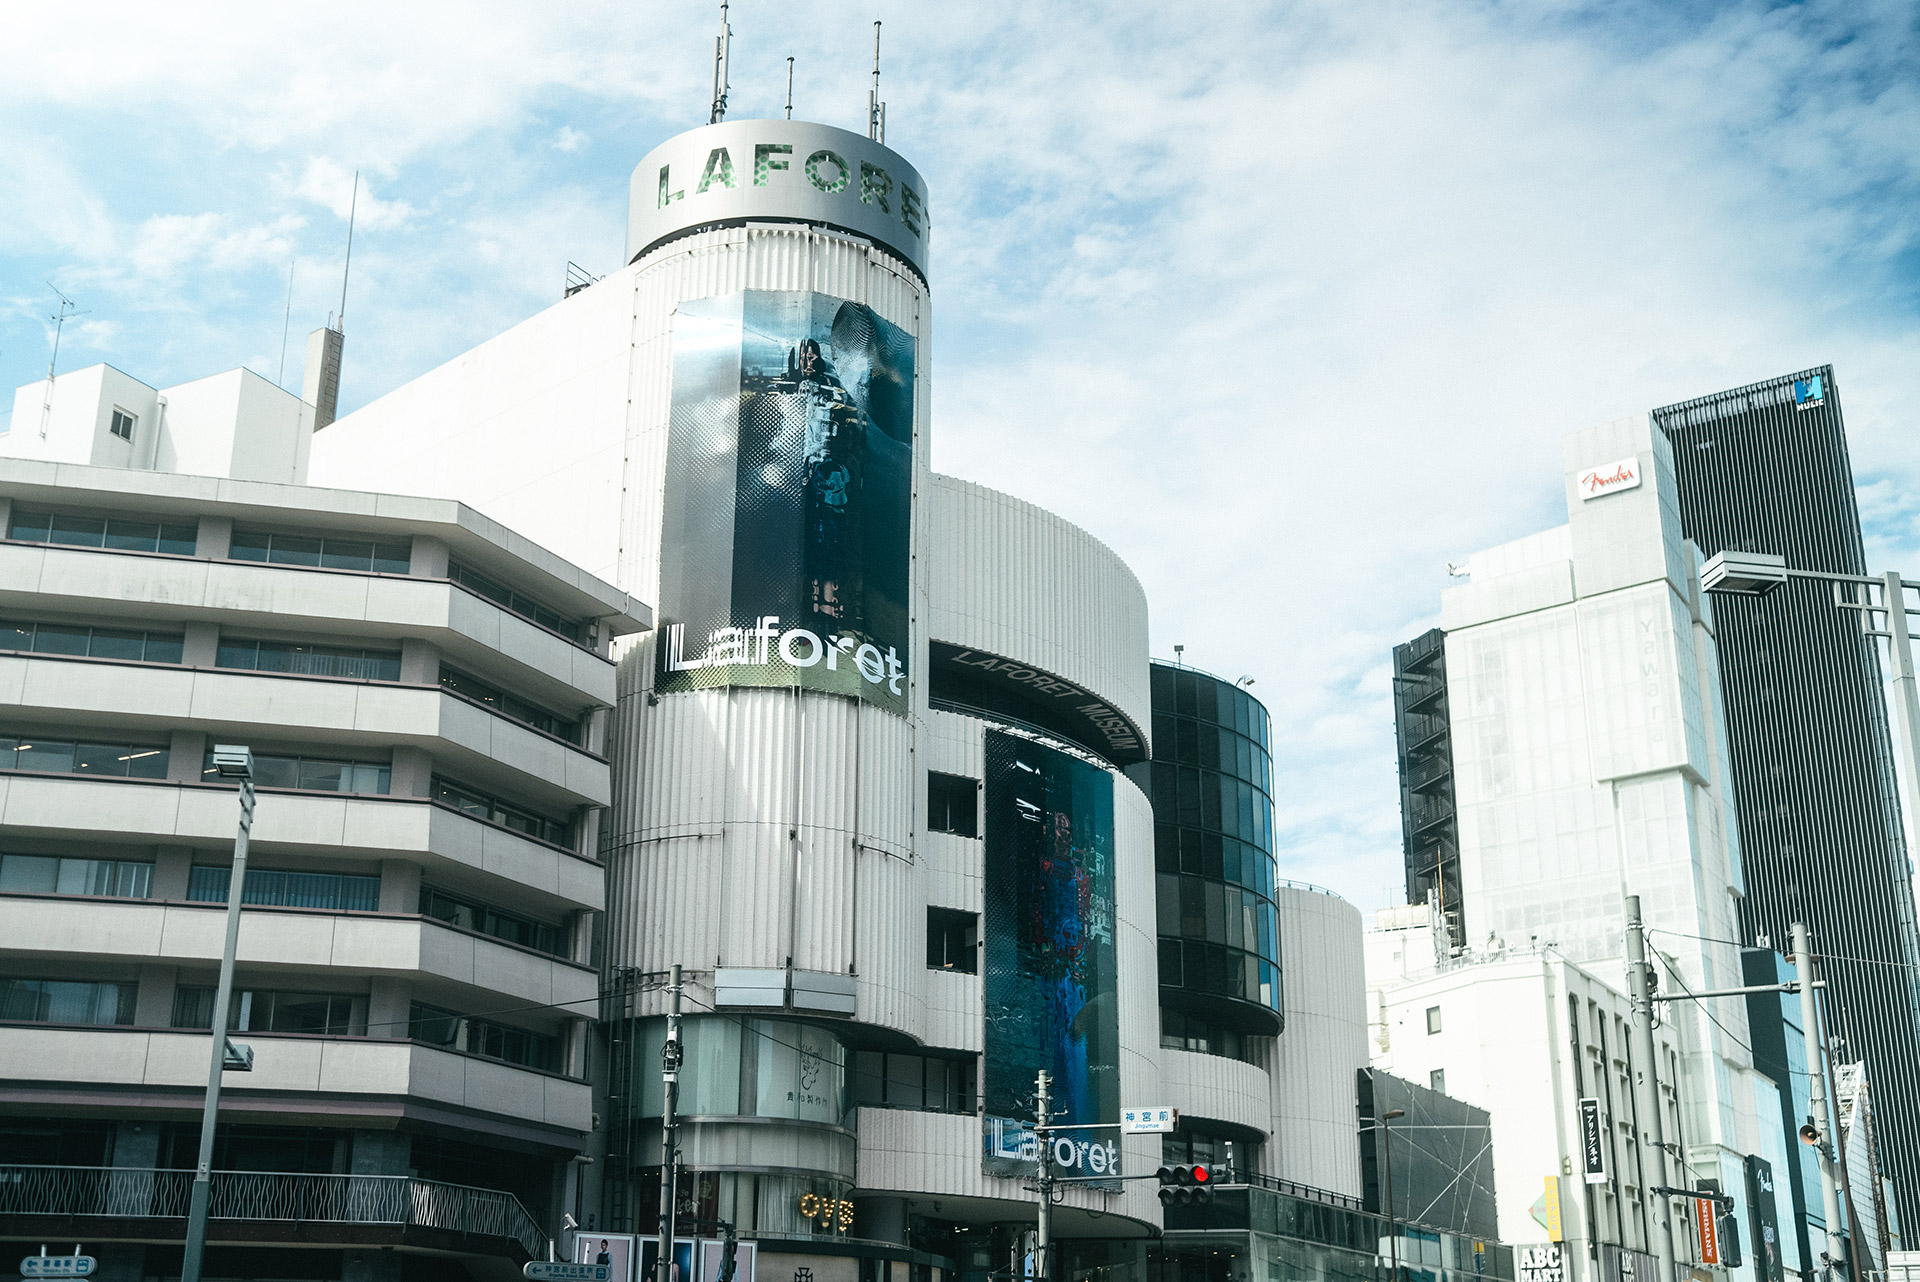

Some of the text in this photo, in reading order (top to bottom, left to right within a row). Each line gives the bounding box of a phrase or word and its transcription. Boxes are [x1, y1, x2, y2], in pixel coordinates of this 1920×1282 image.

[657, 143, 930, 243] LAFORE
[1582, 464, 1633, 491] Fender
[665, 616, 907, 696] Laforet
[952, 651, 1139, 750] LAFORET MUSEUM
[1125, 1111, 1169, 1122] 神宮前
[991, 1118, 1119, 1176] Laoret
[1520, 1247, 1561, 1269] ABC
[1520, 1268, 1562, 1282] MART
